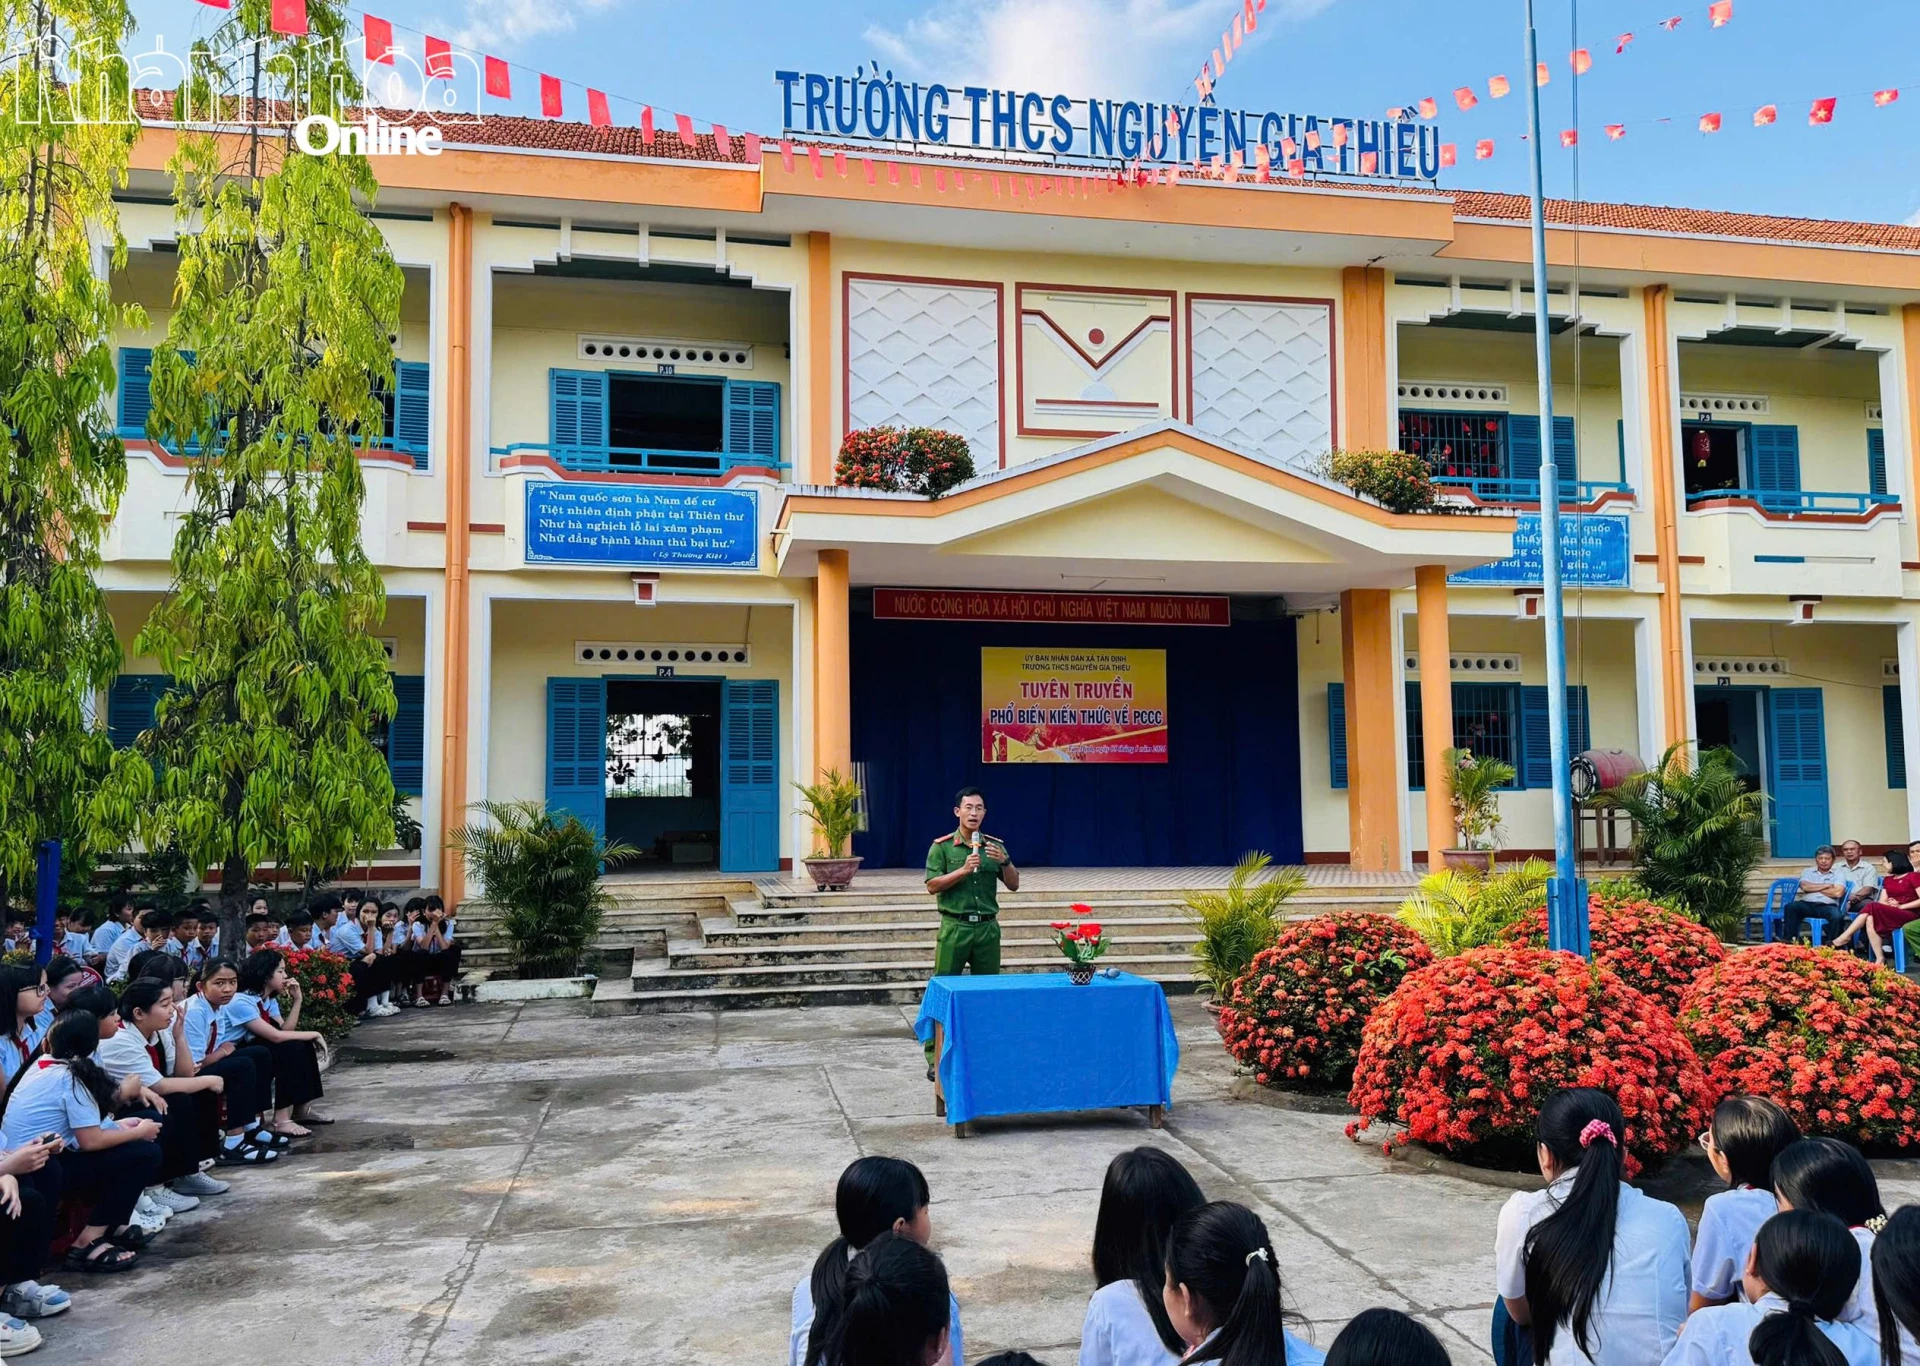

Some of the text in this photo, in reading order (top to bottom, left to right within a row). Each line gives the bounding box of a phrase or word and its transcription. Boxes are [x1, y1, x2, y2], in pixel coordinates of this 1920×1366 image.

[774, 60, 950, 146] TRƯỜNG
[962, 86, 1074, 153] THCS
[1257, 111, 1324, 171] GIA
[660, 366, 673, 374] P.10
[549, 491, 576, 500] Nam
[580, 492, 608, 503] quốc
[612, 495, 632, 503] sơn
[636, 494, 650, 504] hà
[654, 496, 680, 505] Nam
[684, 496, 699, 506] đế
[539, 505, 564, 515] Tiệt
[567, 506, 601, 515] nhiên
[605, 508, 632, 518] định
[636, 509, 665, 519] phận
[688, 510, 720, 520] Thiên
[725, 513, 744, 521] thư
[539, 519, 565, 528] Như
[568, 520, 582, 529] hà
[587, 521, 627, 532] nghịch
[663, 524, 687, 532] xâm
[691, 525, 722, 535] phạm
[1584, 522, 1610, 535] quốc
[601, 535, 631, 544] hành
[634, 536, 664, 545] khan
[691, 538, 708, 549] bại
[1501, 559, 1520, 567] nơi
[895, 593, 1210, 620] NƯỚC CỘNG HÒA XÃ HỘI CHỦ NGHĨA VIỆT NAM MUÔN NĂM
[659, 668, 671, 677] P.4
[1020, 676, 1133, 699] TUYÊN TRUYỀN
[989, 702, 1162, 725] PHỔ BIẾN KIẾN THỨC VỀ PCCC
